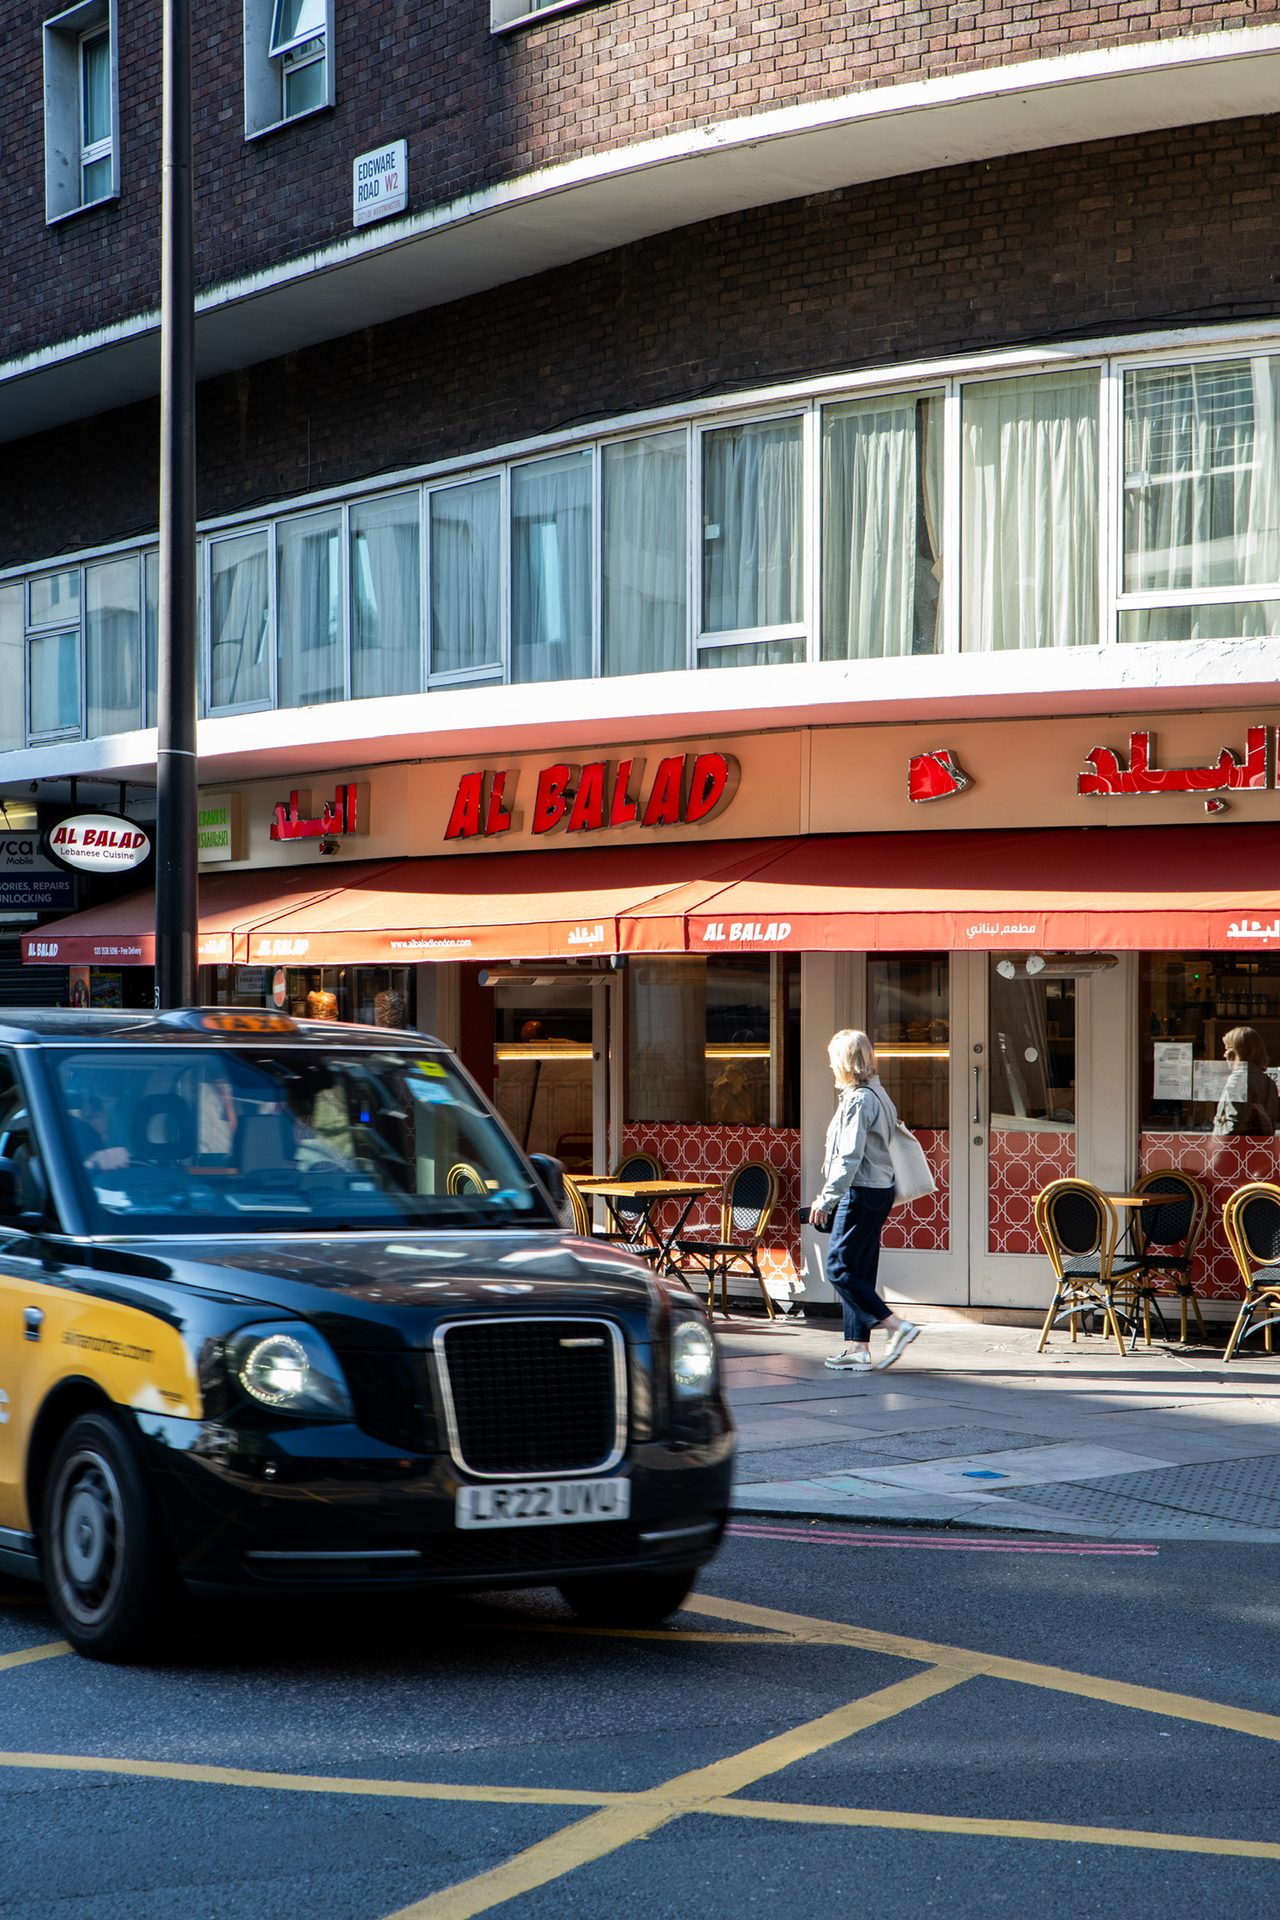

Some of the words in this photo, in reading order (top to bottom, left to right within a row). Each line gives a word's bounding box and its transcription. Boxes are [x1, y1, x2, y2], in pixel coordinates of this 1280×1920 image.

[358, 151, 396, 182] EDGWARE
[358, 180, 380, 203] ROAD
[385, 172, 398, 193] W2
[1077, 724, 1280, 815] لبلد
[444, 769, 514, 840] AL
[532, 753, 733, 835] BALAD
[53, 827, 77, 844] AL
[83, 829, 146, 849] BALAD
[6, 857, 34, 865] Mobile
[60, 847, 100, 857] Lebanese
[103, 850, 134, 860] Cuisine
[33, 881, 70, 890] REPAIRS
[0, 893, 52, 904] NLOCKING
[702, 922, 726, 942] AL
[729, 922, 792, 942] BALAD
[966, 922, 999, 939] لبناني
[1000, 923, 1036, 936] مطعم
[28, 942, 36, 957] AL
[37, 942, 59, 957] BALAD
[256, 939, 272, 956] AL
[272, 939, 309, 956] BALAD
[389, 938, 472, 949] www.albaladlondon.com
[470, 1486, 552, 1521] LR22
